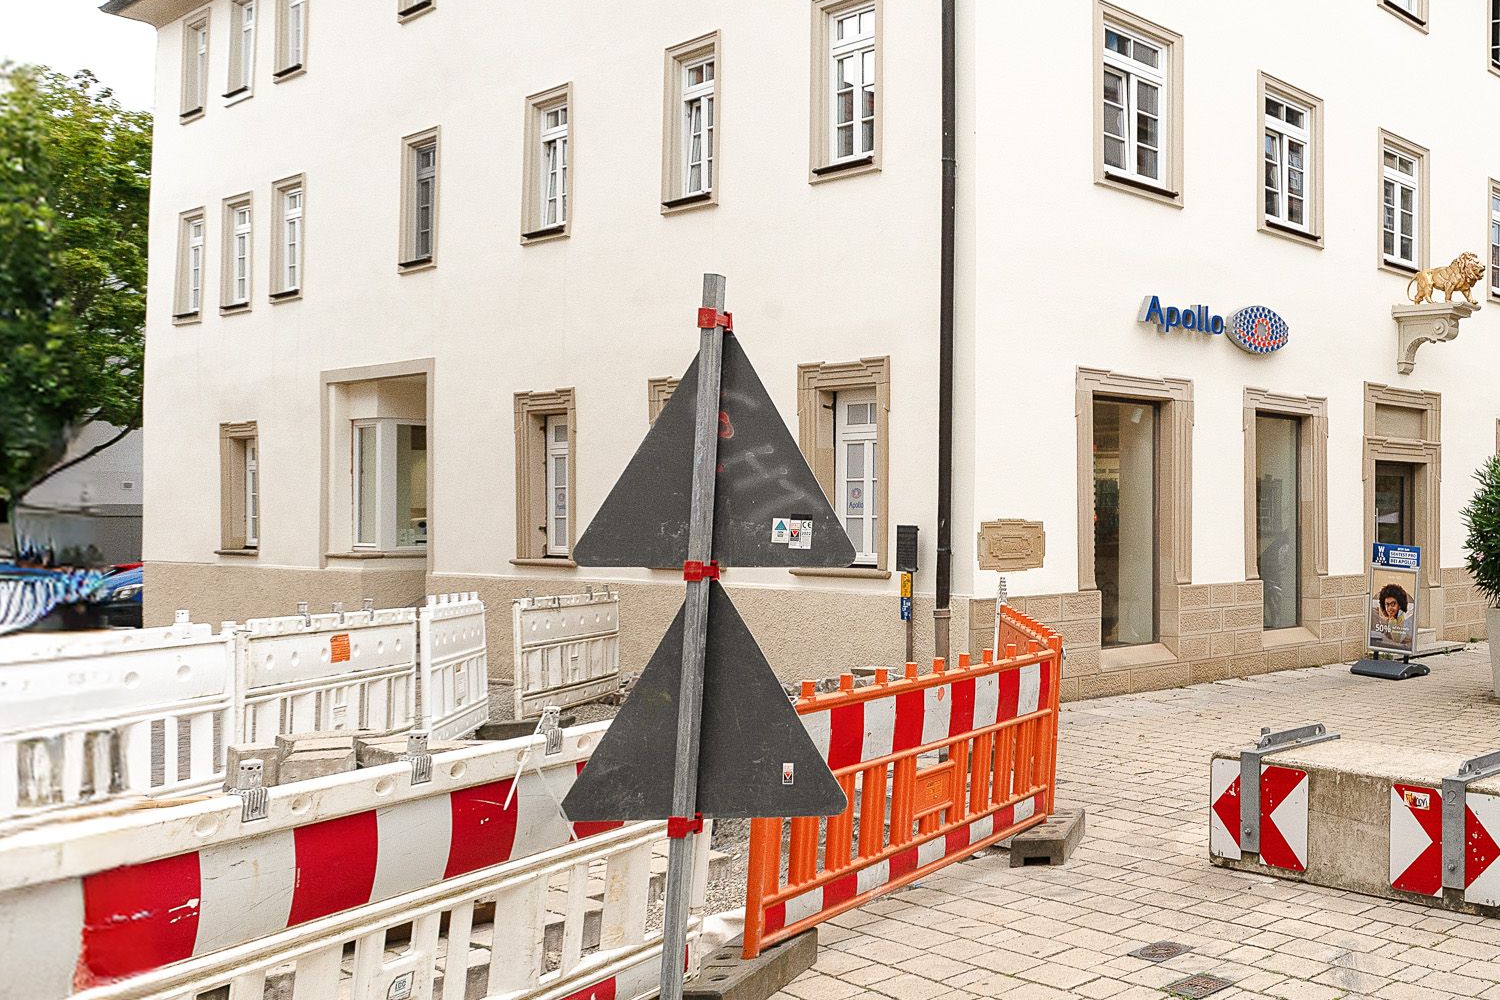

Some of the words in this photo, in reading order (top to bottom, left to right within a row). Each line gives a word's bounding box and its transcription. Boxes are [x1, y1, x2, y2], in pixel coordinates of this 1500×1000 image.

[1144, 295, 1225, 335] Apollo
[802, 521, 812, 529] CE
[1375, 623, 1392, 633] 50%
[1447, 790, 1457, 806] 2
